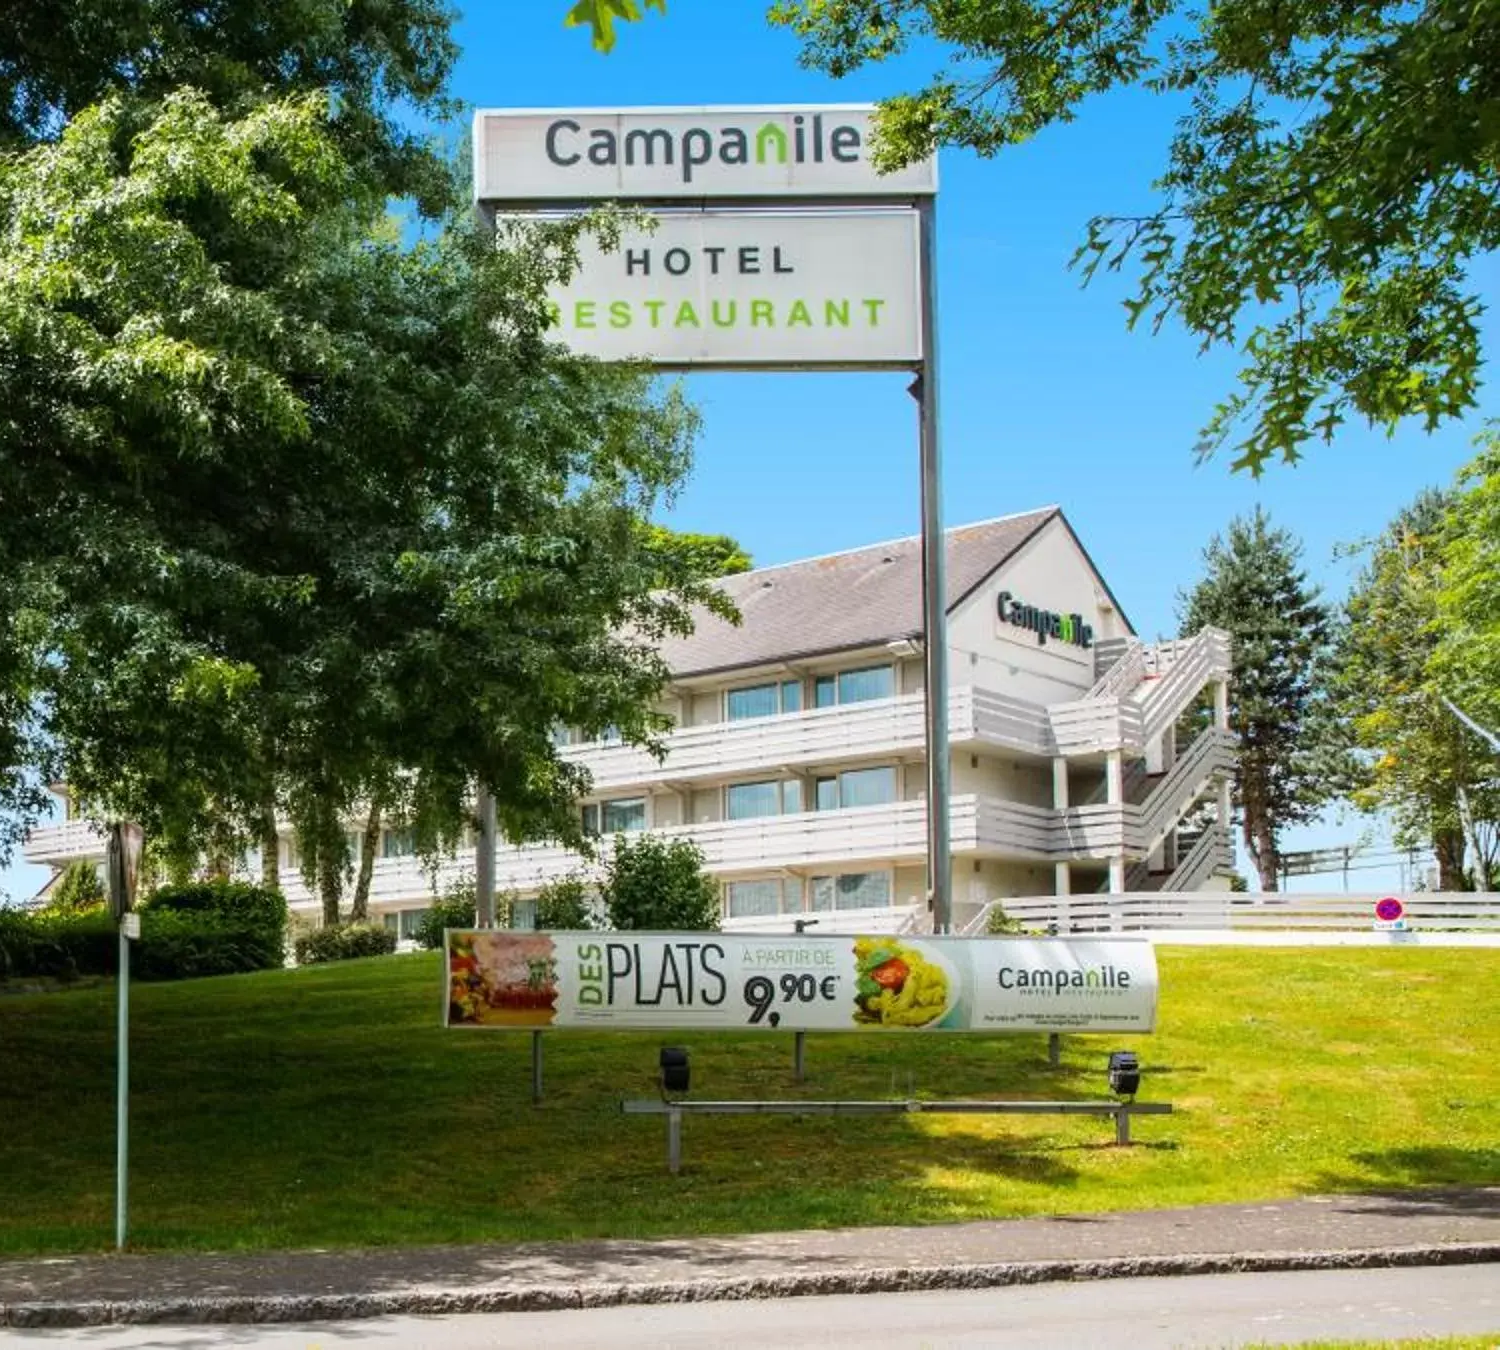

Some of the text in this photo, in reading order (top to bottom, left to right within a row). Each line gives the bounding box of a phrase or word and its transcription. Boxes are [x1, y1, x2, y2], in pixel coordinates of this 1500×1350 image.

[545, 115, 861, 183] Campanile
[626, 246, 794, 276] HOTEL
[997, 591, 1093, 649] Campanile
[578, 943, 603, 1006] DES
[606, 943, 727, 1006] PLATS
[756, 949, 809, 965] PARTIR
[813, 949, 836, 965] DE
[999, 966, 1130, 995] Campanile
